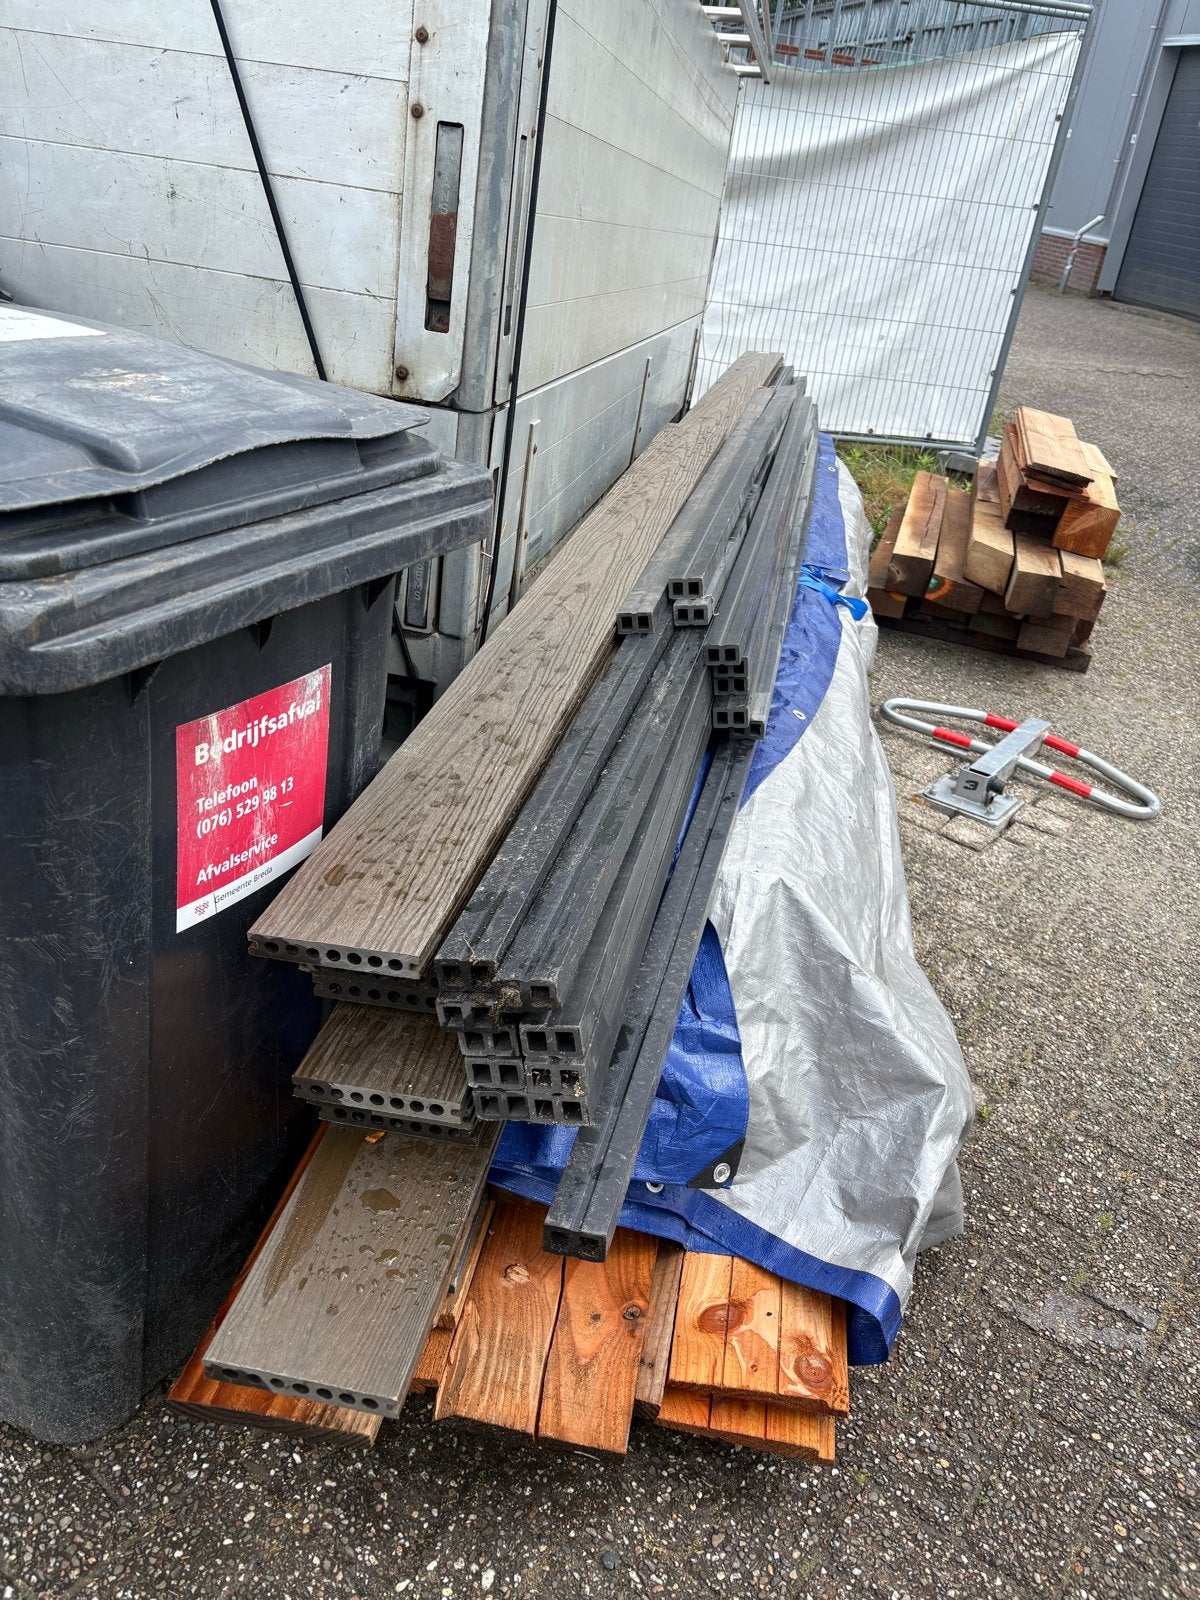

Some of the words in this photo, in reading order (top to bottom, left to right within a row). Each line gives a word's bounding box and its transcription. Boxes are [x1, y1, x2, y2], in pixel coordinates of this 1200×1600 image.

[196, 776, 258, 813] Telefoon
[963, 780, 979, 790] 3
[197, 808, 232, 839] (076)
[236, 795, 260, 819] 529
[262, 786, 277, 805] 98
[280, 776, 294, 795] 13
[196, 833, 278, 885] Afvalservice
[214, 879, 252, 904] Gemeente
[253, 866, 273, 883] Breda
